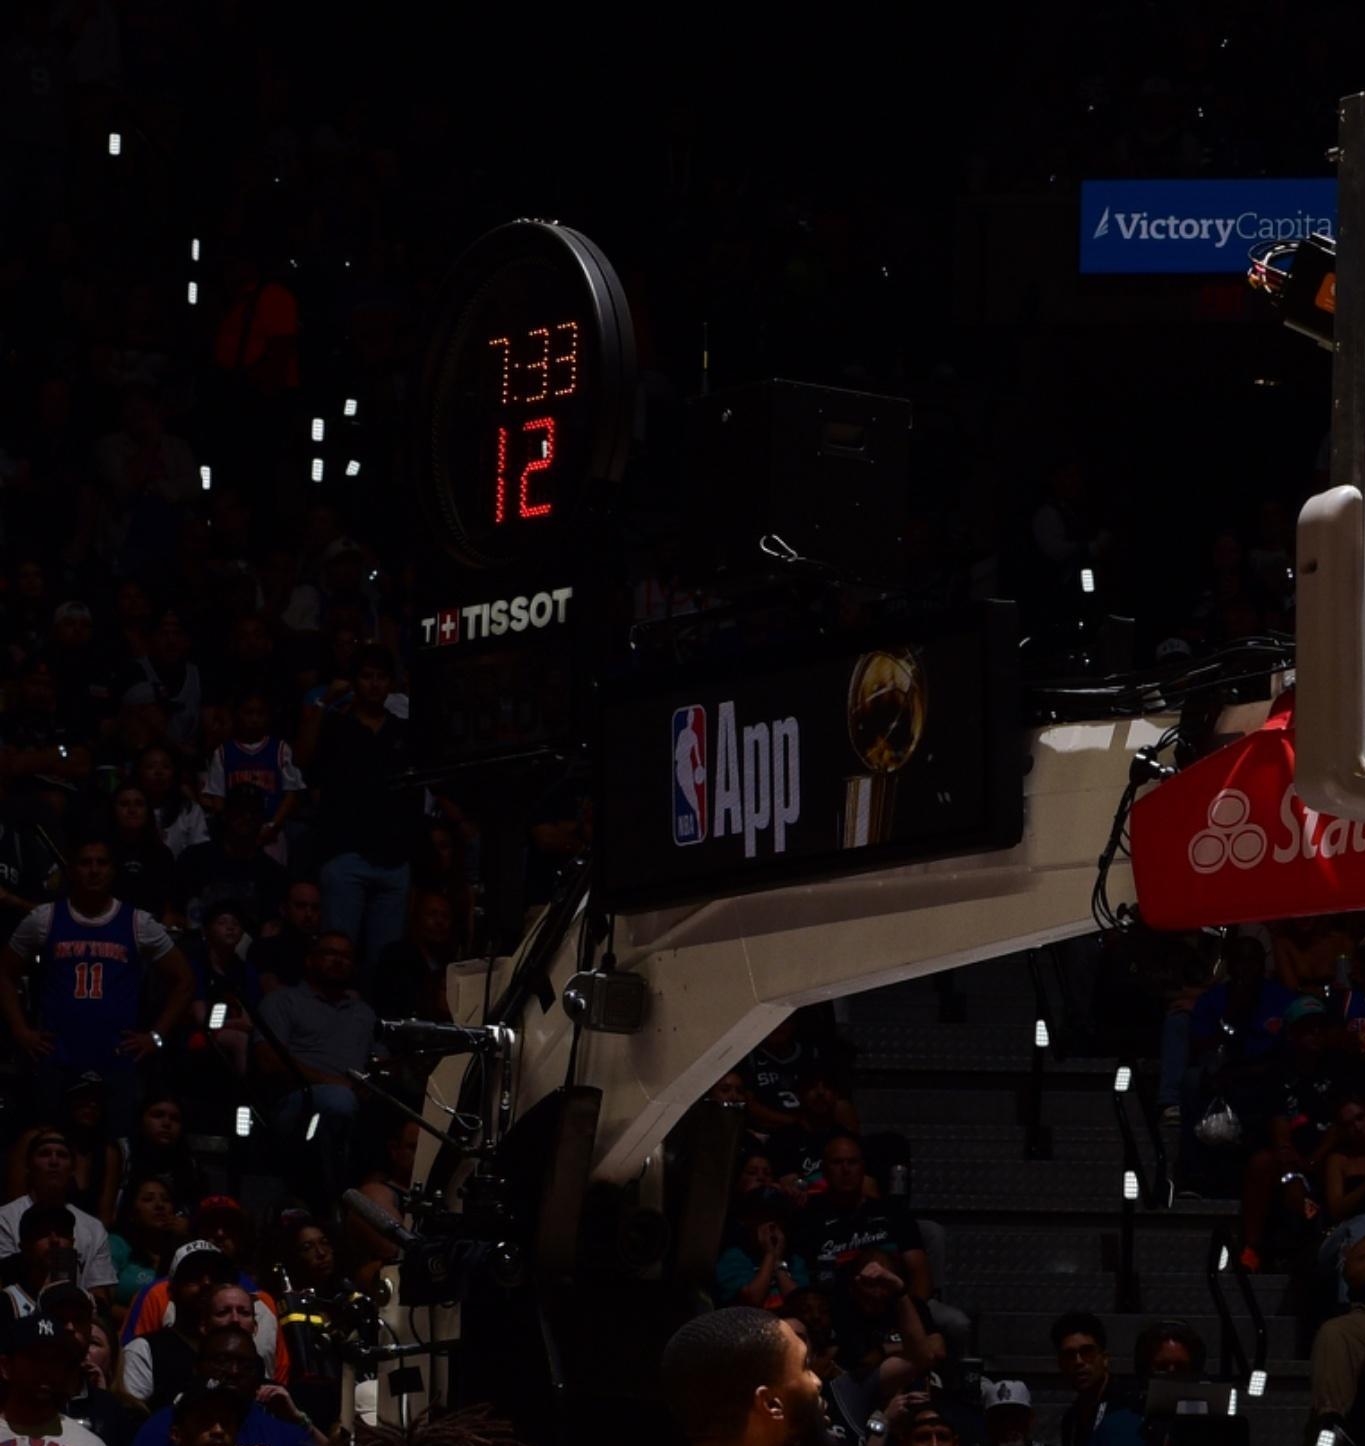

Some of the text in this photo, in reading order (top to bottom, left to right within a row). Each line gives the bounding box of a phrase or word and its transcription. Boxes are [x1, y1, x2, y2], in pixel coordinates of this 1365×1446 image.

[1115, 210, 1333, 247] VictoryCapita
[489, 320, 579, 406] 7:33
[494, 417, 555, 524] 12
[462, 587, 573, 640] TISSOT
[714, 700, 801, 858] App
[74, 961, 104, 1000] 11
